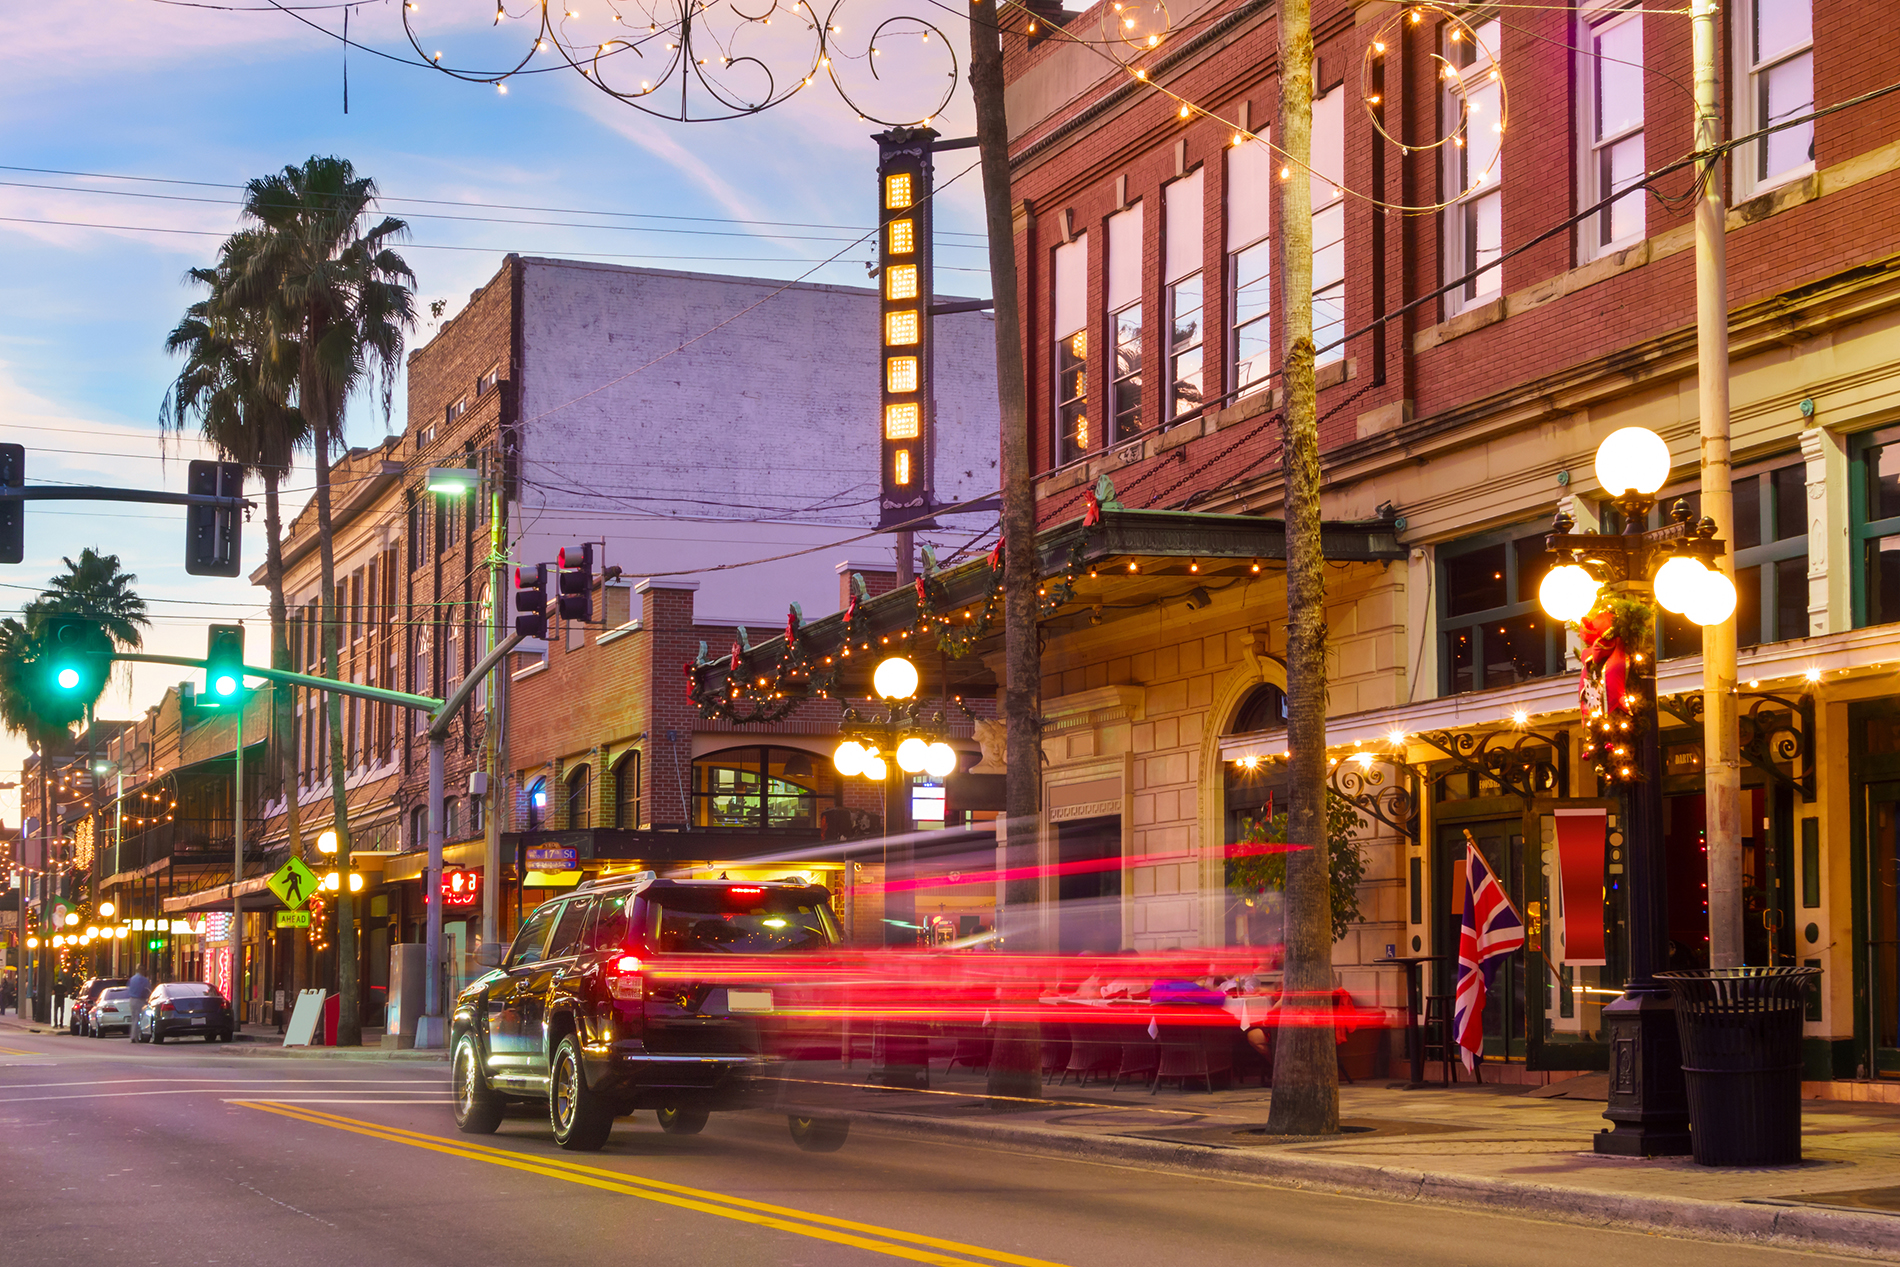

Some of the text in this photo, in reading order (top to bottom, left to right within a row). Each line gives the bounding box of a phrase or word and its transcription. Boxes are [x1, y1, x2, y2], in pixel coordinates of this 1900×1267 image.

[1675, 753, 1692, 764] DARTS
[564, 850, 573, 858] St
[281, 915, 306, 923] AHEAD
